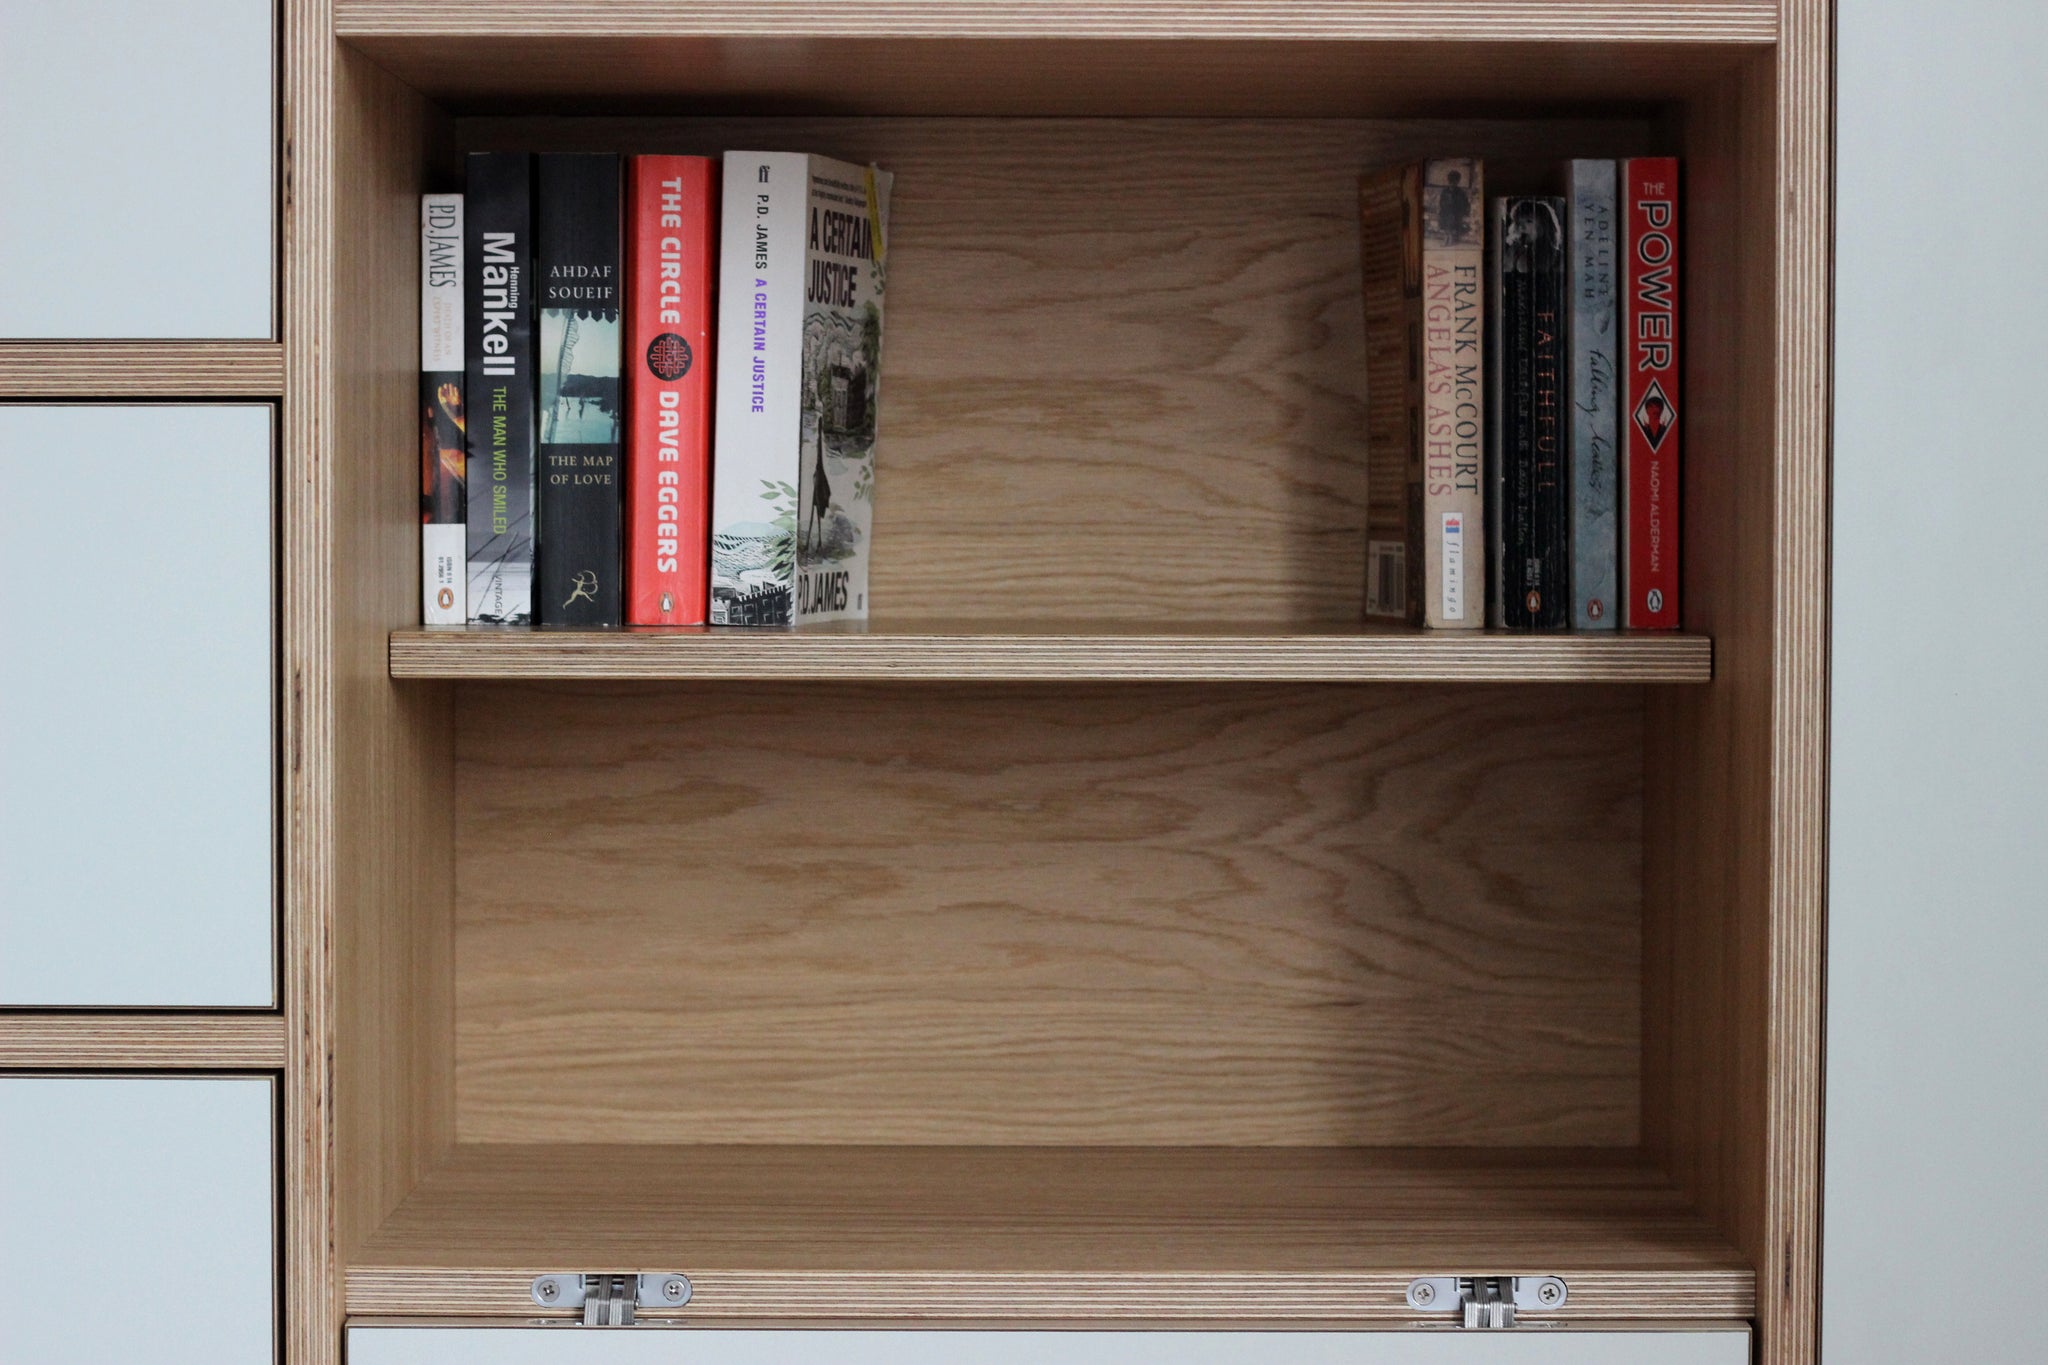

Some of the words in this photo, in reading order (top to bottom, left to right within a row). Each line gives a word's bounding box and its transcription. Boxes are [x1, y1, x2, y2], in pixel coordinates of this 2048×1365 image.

[661, 177, 681, 228] THE
[757, 194, 769, 219] P.D.
[1643, 182, 1665, 195] THE
[810, 206, 819, 251] A
[1584, 203, 1595, 241] YEN
[755, 224, 769, 270] JAMES
[1598, 205, 1609, 297] ADELINE
[508, 266, 520, 309] Henning
[548, 286, 613, 299] SOUEIF
[550, 265, 612, 278] AHDAF
[660, 237, 681, 324] CIRCLE
[755, 278, 768, 287] A
[808, 259, 858, 309] JUSTICE
[1584, 255, 1595, 299] MAH
[1638, 200, 1672, 372] POWER
[483, 232, 516, 376] Mankell
[753, 292, 767, 351] CERTAIN
[1454, 264, 1478, 354] FRANK
[1427, 264, 1452, 395] ANGELA'S
[493, 386, 507, 411] THE
[751, 356, 766, 413] JUSTICE
[1537, 312, 1555, 493] FAITHFULL
[493, 415, 507, 446] MAN
[658, 391, 680, 462] DAVE
[493, 449, 507, 481] WHO
[548, 455, 578, 467] THE
[583, 455, 613, 467] MAP
[1428, 405, 1452, 496] ASHES
[550, 474, 569, 485] OF
[574, 474, 612, 486] LOVE
[1650, 460, 1661, 501] NAOMI
[493, 486, 507, 535] SMILED
[657, 470, 679, 573] EGGERS
[1650, 504, 1661, 573] ALDERMAN
[494, 575, 503, 615] VINTAGE
